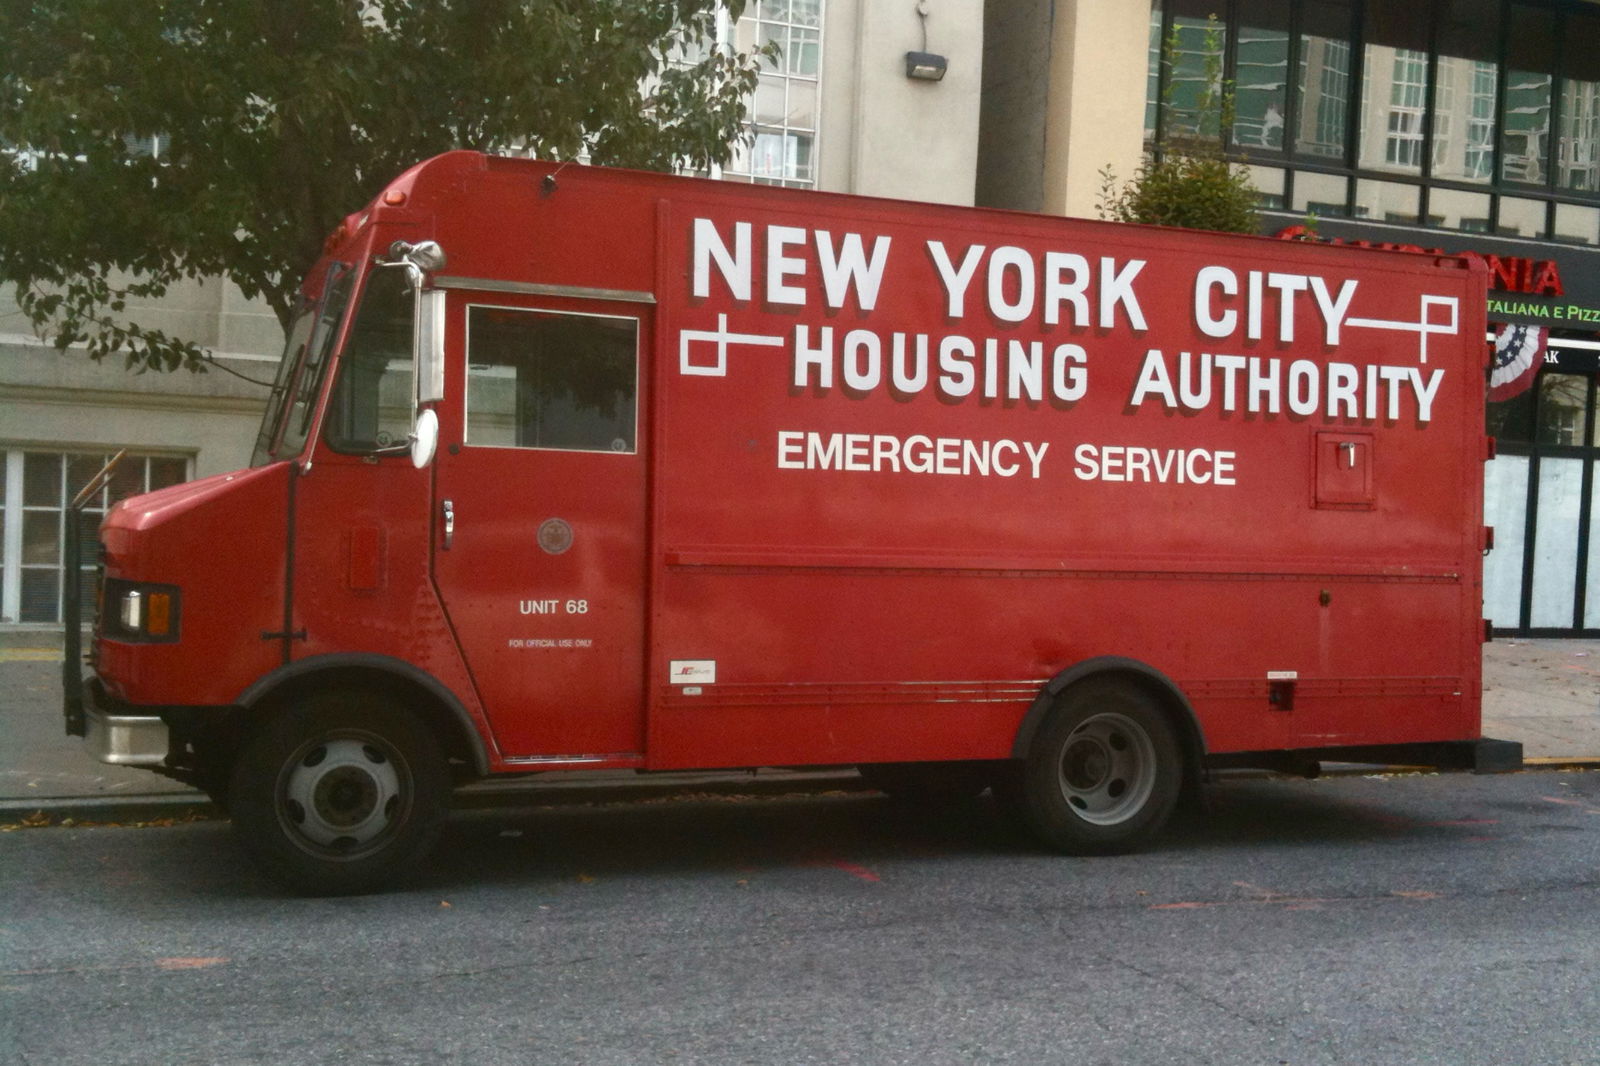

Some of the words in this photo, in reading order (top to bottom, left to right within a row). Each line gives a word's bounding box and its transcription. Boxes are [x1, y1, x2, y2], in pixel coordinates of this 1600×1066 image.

[692, 217, 892, 311] NEW
[926, 239, 1149, 332] YORK
[1194, 265, 1359, 346] CITY
[1553, 306, 1564, 319] E
[793, 324, 1088, 402] HOUSING
[1130, 349, 1446, 422] AUTHORITY
[777, 430, 1050, 479] EMERGENCY
[1073, 443, 1237, 487] SERVICE
[519, 599, 560, 615] UNIT
[565, 599, 589, 614] 68
[508, 639, 524, 648] FOR
[526, 639, 556, 648] OFFICIAL
[558, 639, 573, 648] USE
[575, 639, 593, 648] ONLY
